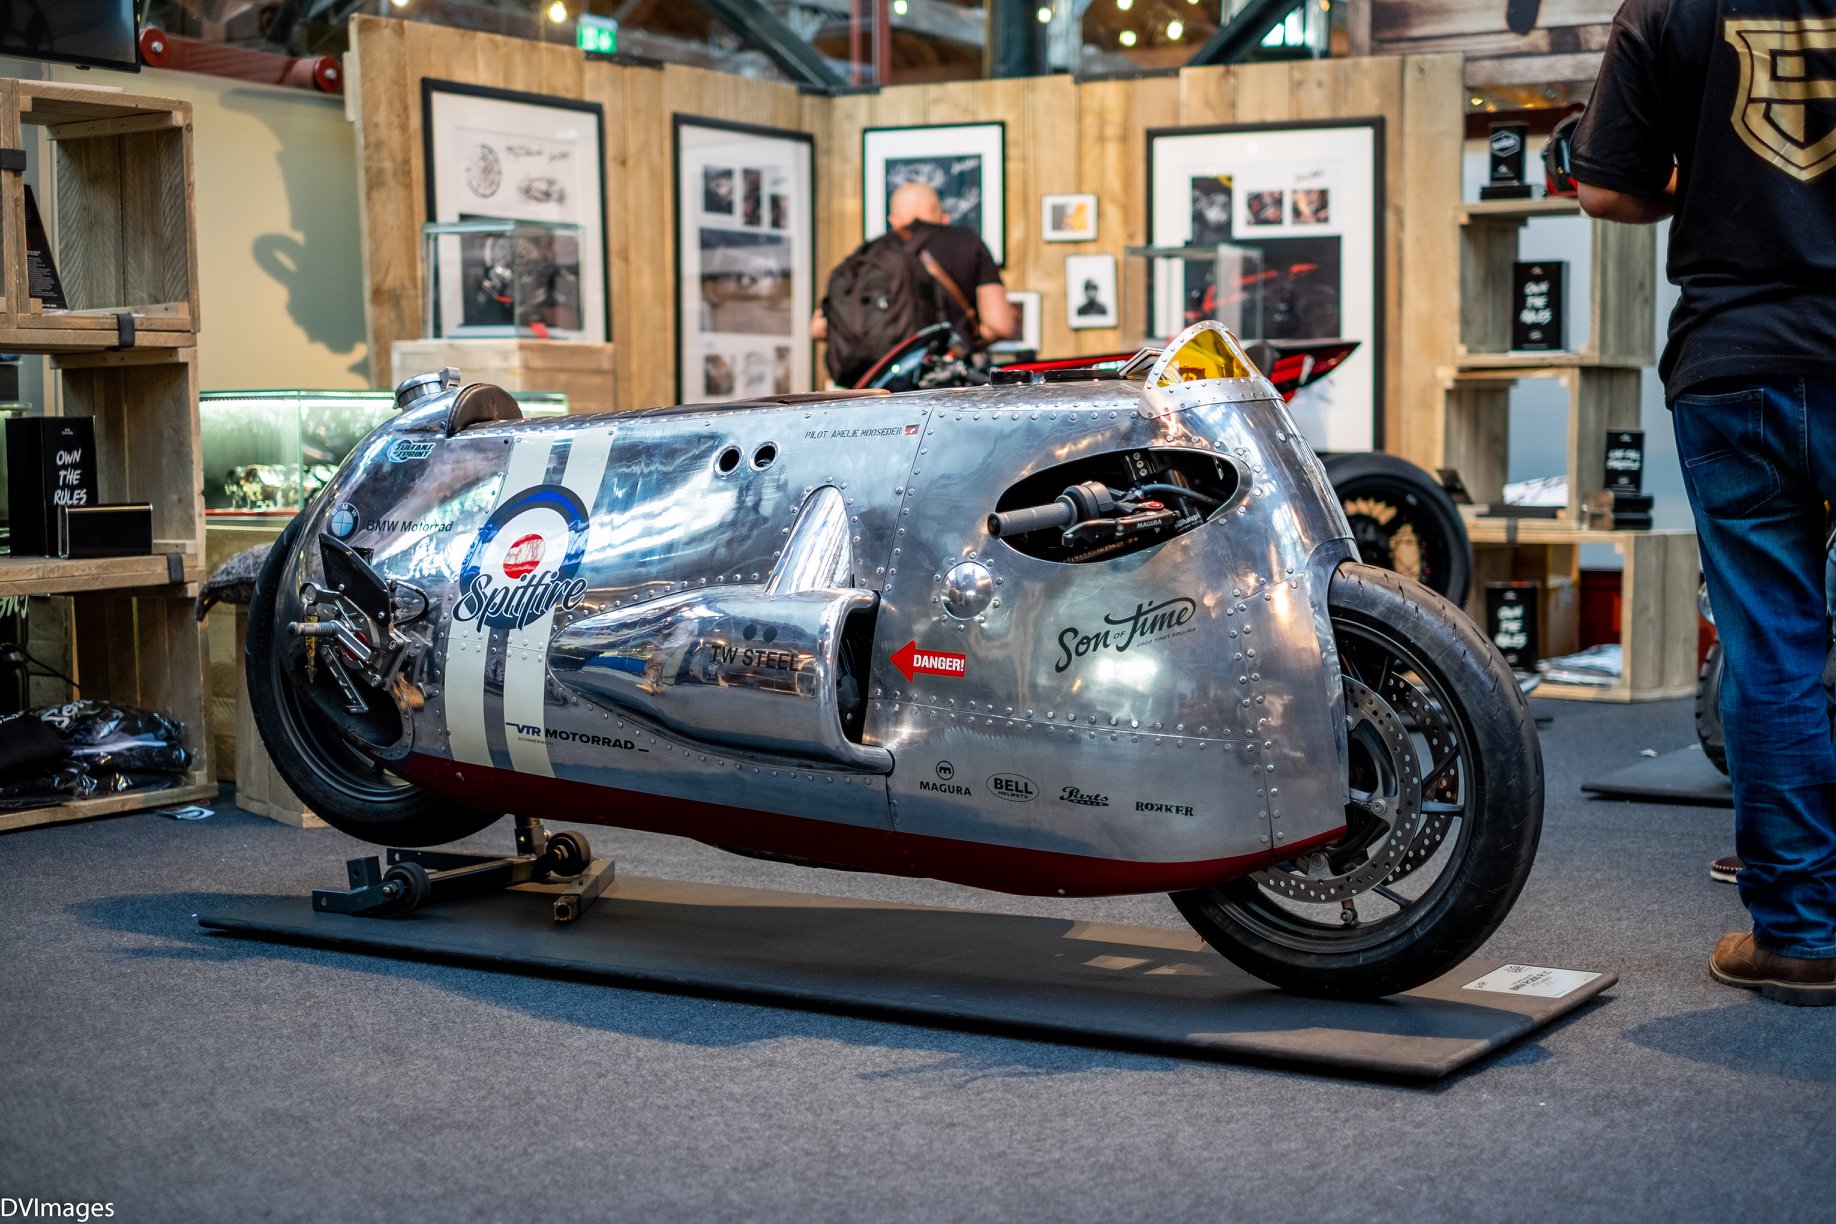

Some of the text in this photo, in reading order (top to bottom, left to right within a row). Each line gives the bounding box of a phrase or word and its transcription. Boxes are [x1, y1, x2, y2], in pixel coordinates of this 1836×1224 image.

[804, 430, 829, 439] PILOT
[56, 448, 82, 466] OWN
[397, 450, 430, 458] SPRINT
[58, 467, 82, 486] THE
[54, 488, 87, 505] RULES
[366, 520, 455, 533] BMW Motorrad
[1136, 519, 1163, 529] MAGURA
[452, 570, 587, 633] Spitfire
[1055, 597, 1196, 673] Son OF Time
[711, 645, 800, 672] TW STEEL
[913, 654, 965, 672] DANGER!
[516, 724, 635, 750] VTR MOTORRAD
[920, 780, 972, 797] MAGURA
[993, 777, 1034, 795] BELL
[1059, 786, 1109, 801] Parts
[1135, 801, 1194, 817] ROKKER
